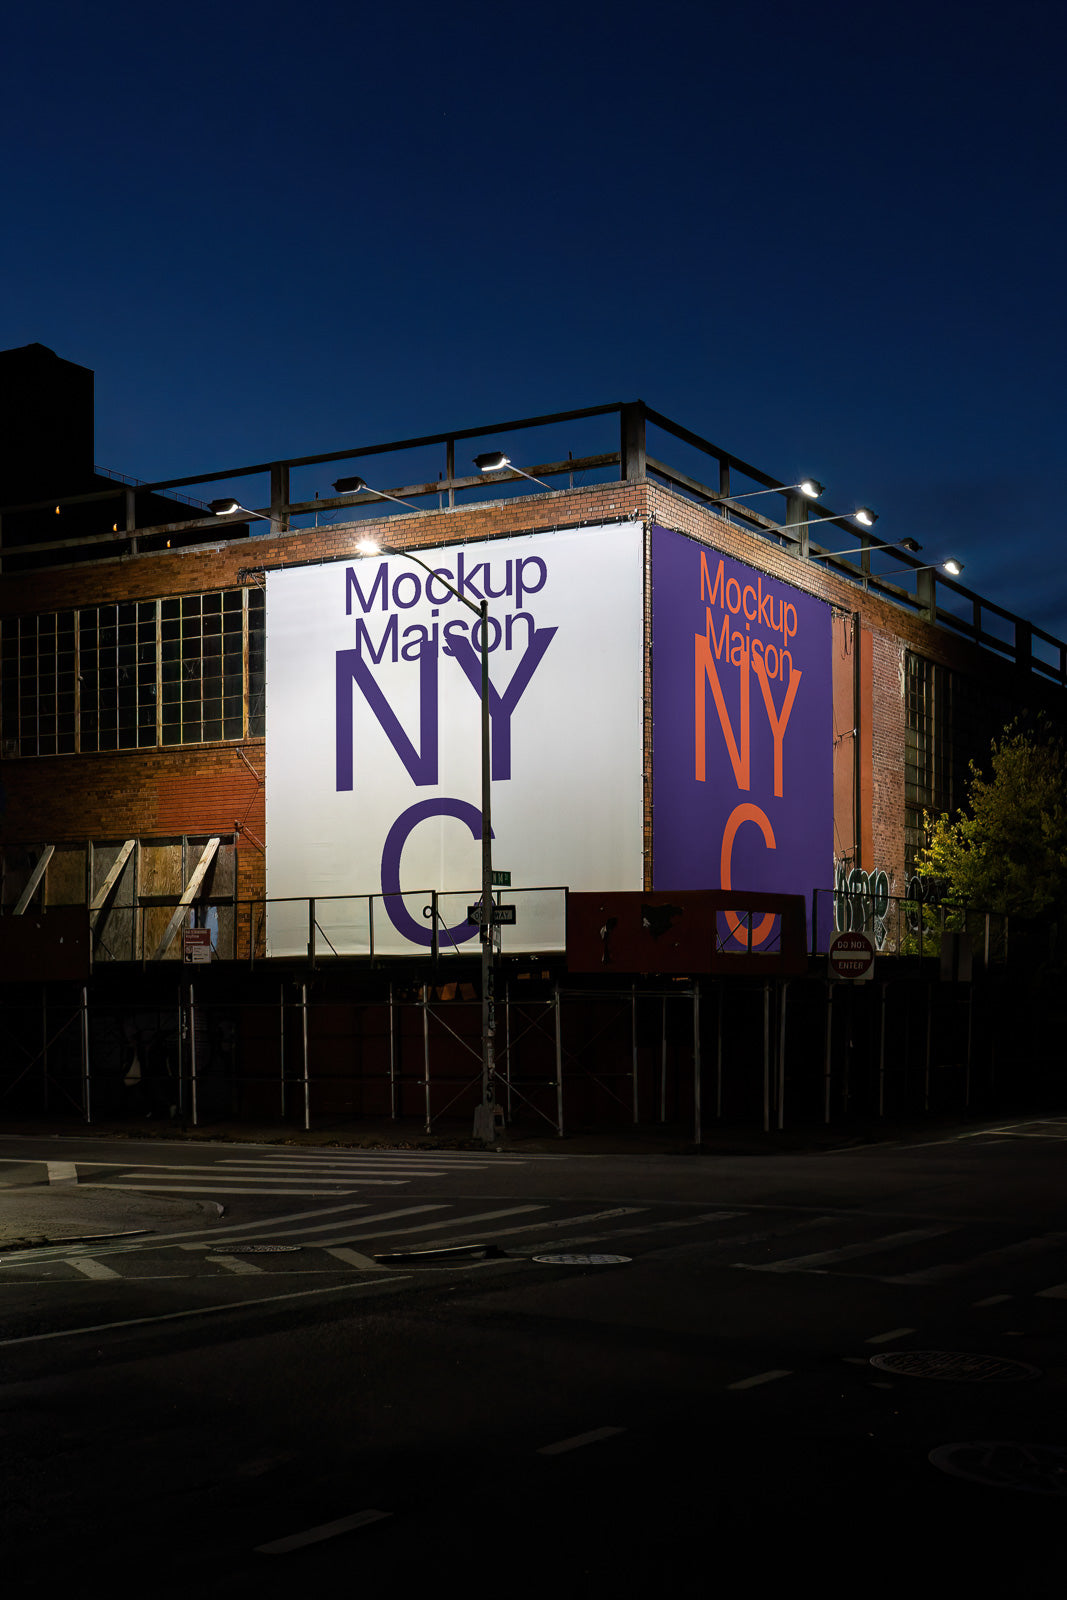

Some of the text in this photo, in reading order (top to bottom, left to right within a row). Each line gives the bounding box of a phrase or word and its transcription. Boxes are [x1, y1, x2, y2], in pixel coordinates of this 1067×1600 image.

[346, 552, 547, 616] Mockup
[701, 551, 797, 647] Mockup
[356, 608, 535, 665] Maison
[707, 606, 794, 681] Maison
[336, 626, 559, 792] NY
[695, 633, 802, 798] NY
[381, 797, 496, 948] C
[721, 802, 777, 947] C
[837, 941, 865, 949] DO NOT
[838, 961, 864, 969] ENTER
